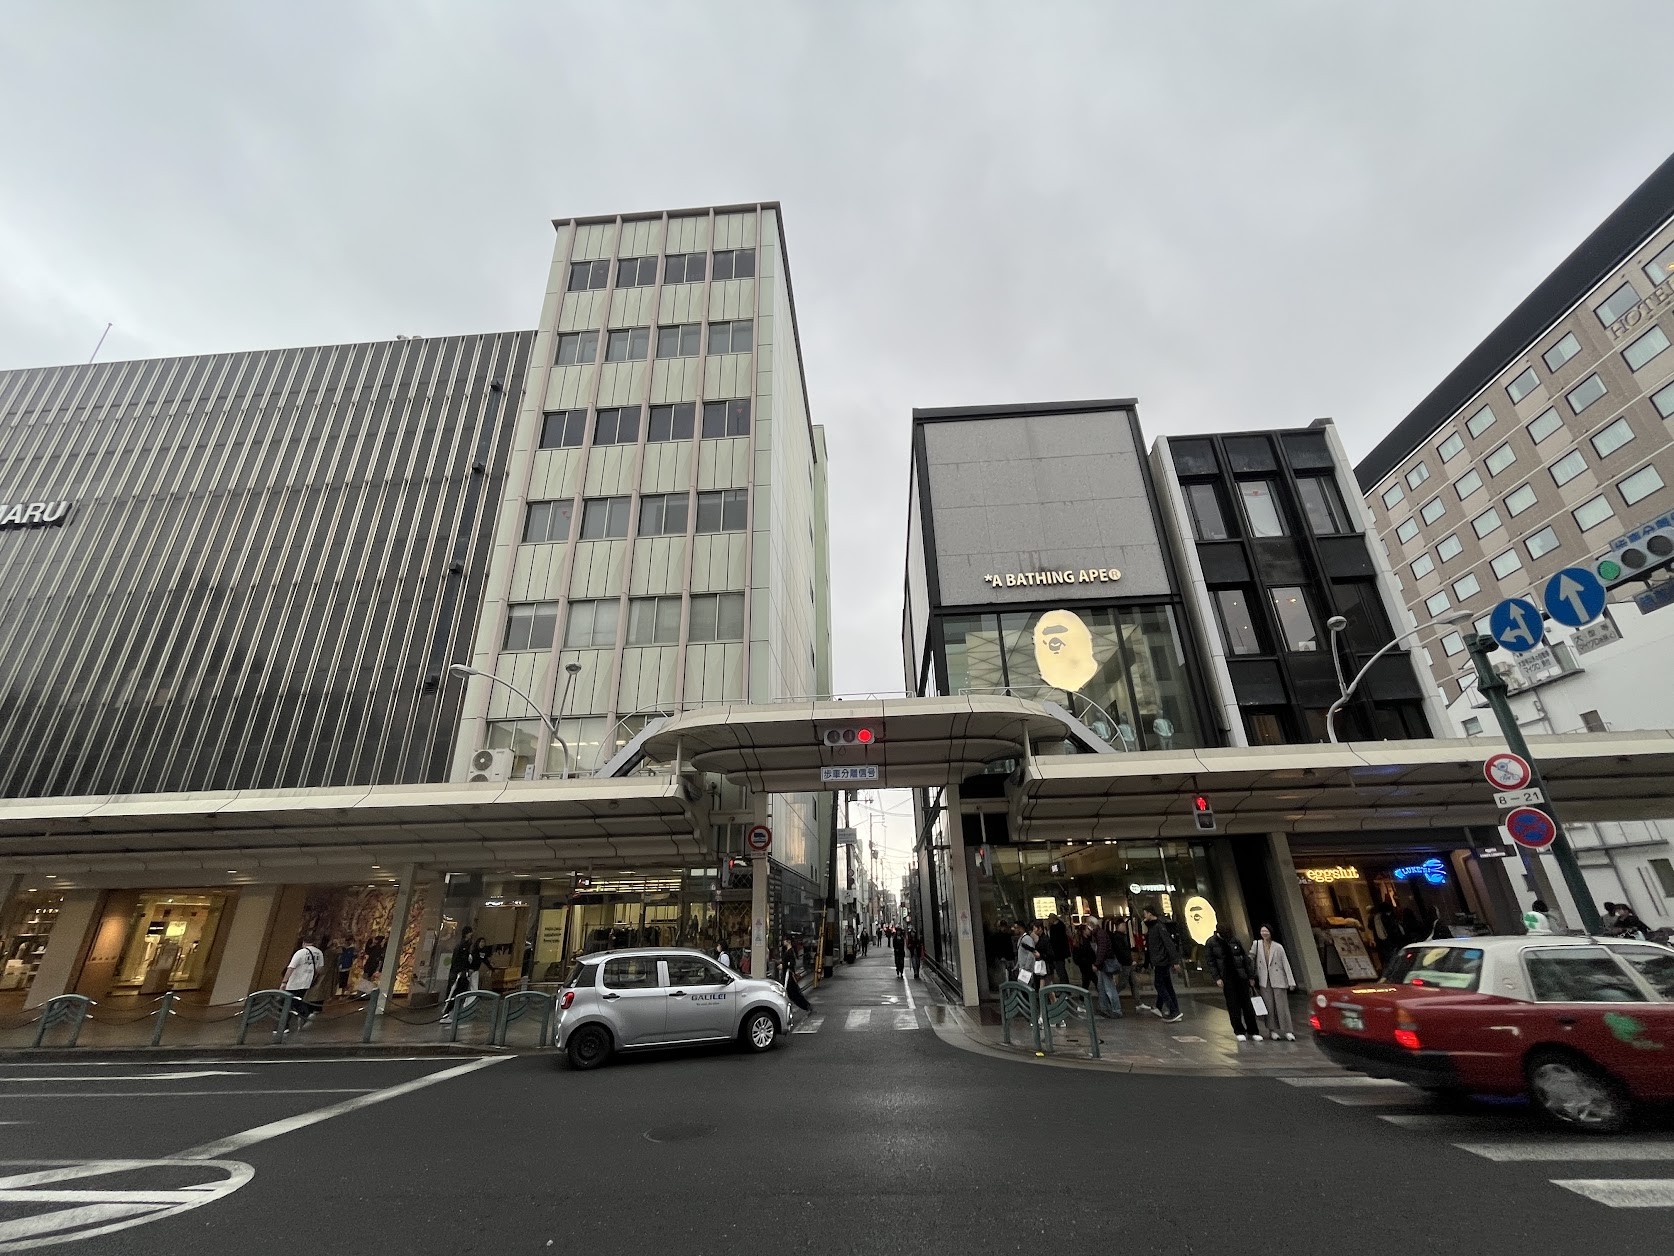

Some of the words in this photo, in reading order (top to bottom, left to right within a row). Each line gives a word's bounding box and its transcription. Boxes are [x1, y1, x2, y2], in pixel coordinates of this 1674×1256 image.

[1006, 570, 1075, 587] BATHING
[824, 768, 875, 779] 歩車分離信号
[1499, 796, 1507, 805] 8
[1524, 792, 1540, 802] 21
[1306, 866, 1359, 882] eggslut
[691, 993, 726, 1001] GALILEI
